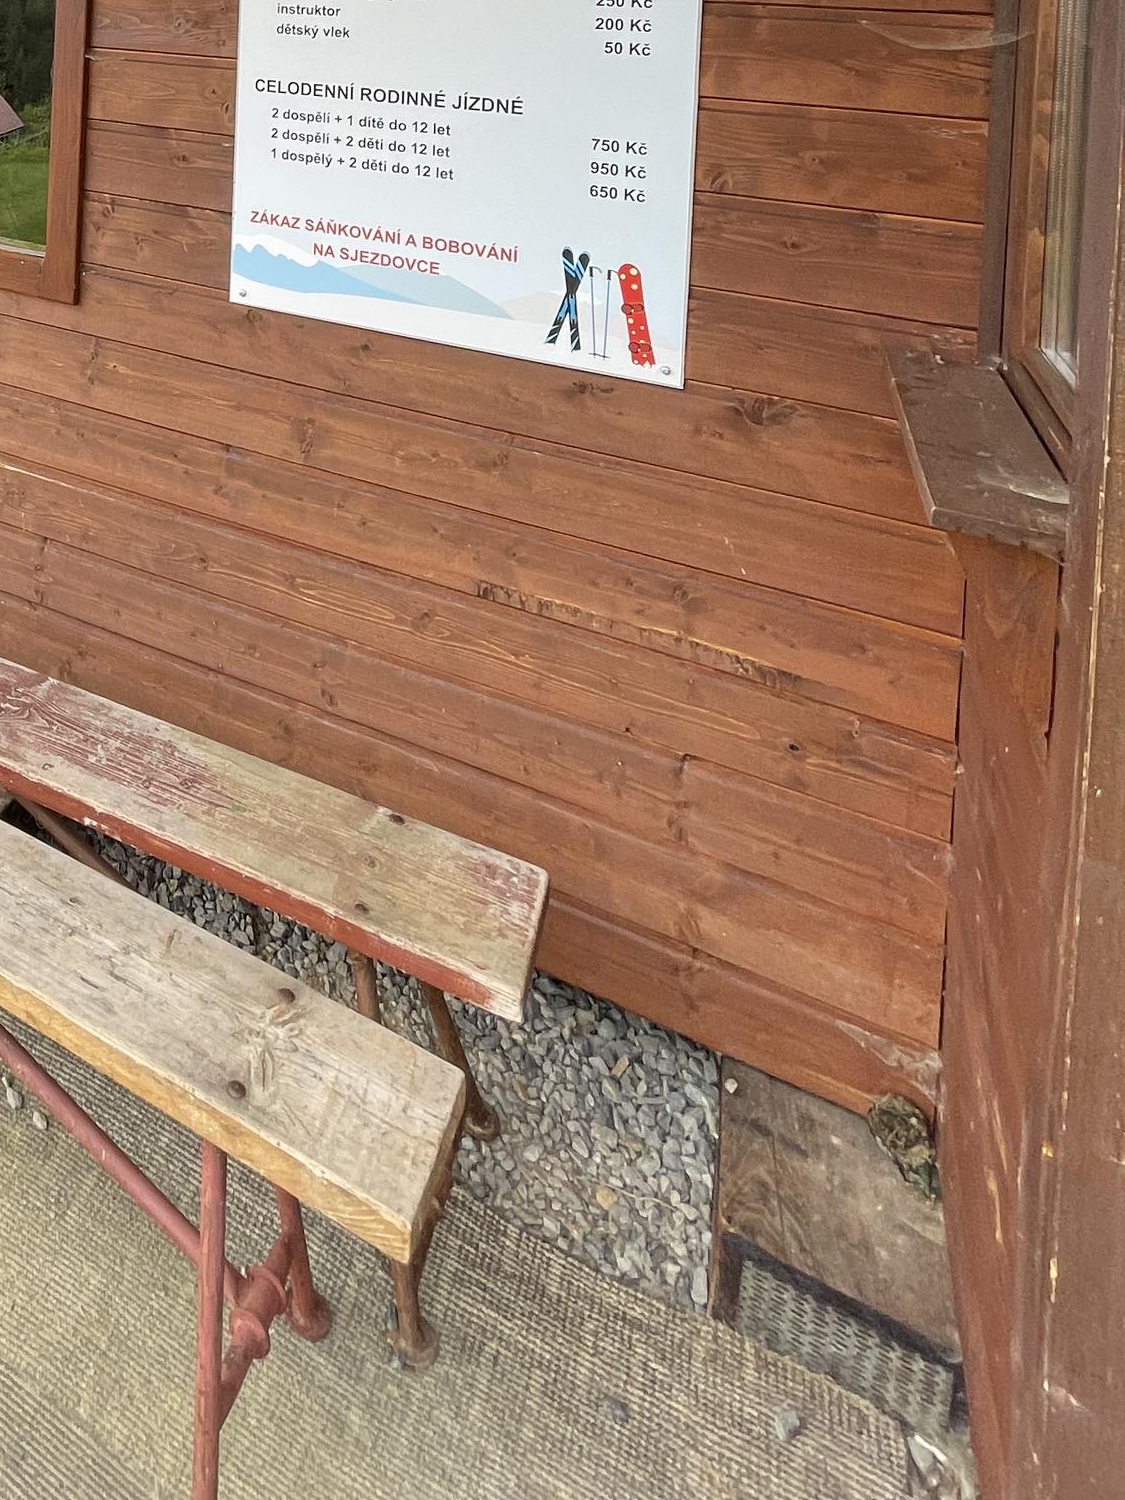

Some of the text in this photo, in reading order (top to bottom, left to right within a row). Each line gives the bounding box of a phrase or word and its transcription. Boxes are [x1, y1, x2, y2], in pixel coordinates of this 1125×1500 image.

[277, 3, 341, 17] instruktor
[276, 23, 350, 39] dětský vlek
[595, 18, 652, 33] 200 Kč
[604, 41, 651, 56] 50 Kč
[254, 79, 524, 115] CELODENNÍ RODINNÉ JÍZDNÉ
[271, 107, 451, 136] 2 dospělí + 1 dítě do 12 let
[271, 127, 450, 158] 2 dospělí + 2 děti do 12 let
[591, 138, 648, 155] 750 Kč
[271, 148, 454, 180] 1 dospělý + 2 děti do 12 let
[590, 161, 647, 179] 950 Kč
[590, 185, 646, 203] 650 Kč
[250, 209, 519, 263] ZÁKAZ SÁŇKOVÁNÍ A BOBOVÁNÍ
[313, 243, 441, 275] NA SJEZDOVCE
